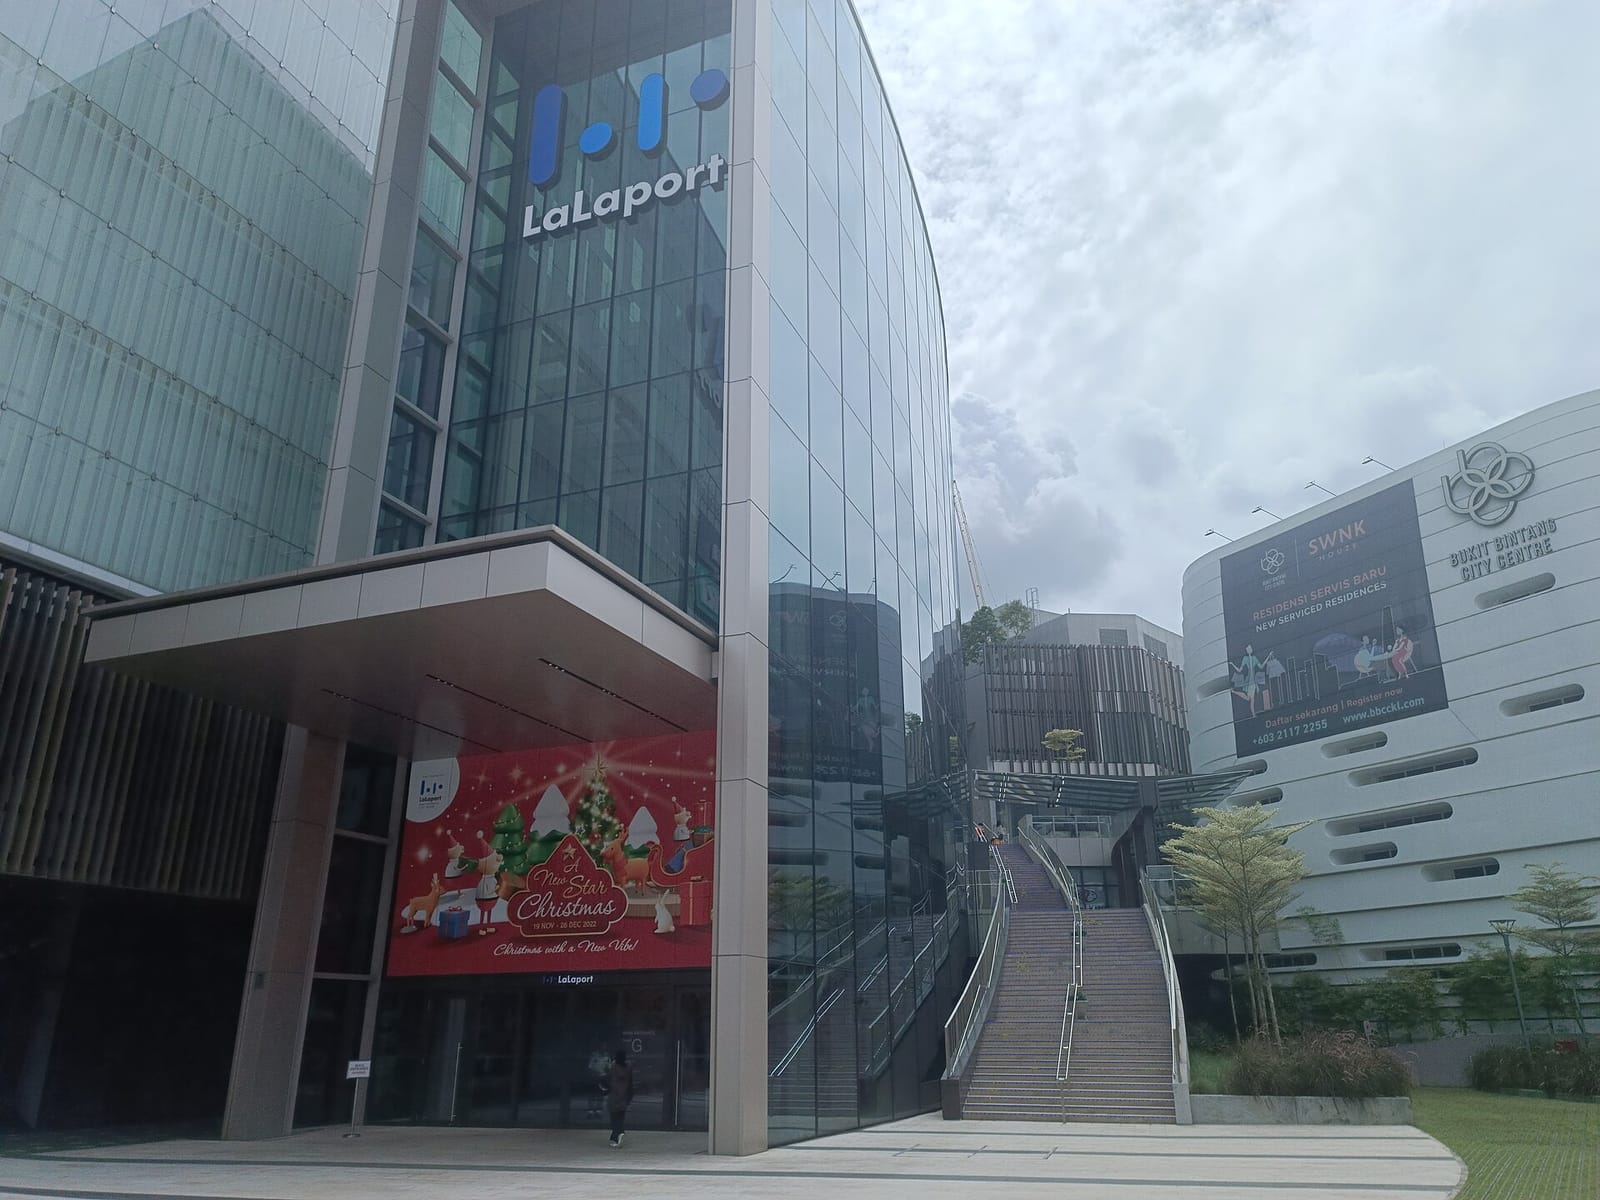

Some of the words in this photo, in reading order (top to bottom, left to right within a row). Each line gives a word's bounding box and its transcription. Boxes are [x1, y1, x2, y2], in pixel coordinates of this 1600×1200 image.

[522, 153, 724, 239] LaLaport
[1308, 519, 1367, 556] SWNK
[1450, 541, 1489, 568] BUKIT
[1495, 518, 1557, 551] BINTANG
[1461, 559, 1492, 581] CITY
[1497, 538, 1553, 569] CENTRE
[1253, 595, 1308, 621] RESIDENSI
[1310, 578, 1351, 601] SERVIS
[1353, 566, 1386, 584] BARU
[1255, 618, 1277, 633] NEW
[1278, 602, 1323, 625] SERVICED
[1325, 582, 1387, 608] RESIDENCES
[1252, 733, 1275, 746] +603
[1277, 725, 1301, 741] 2117
[1303, 718, 1329, 734] 2255
[1342, 696, 1426, 725] www.bbcckl.com
[1265, 715, 1294, 729] Daftar
[1384, 686, 1404, 697] now
[533, 869, 568, 888] New
[562, 875, 608, 899] Star
[563, 859, 581, 874] A
[517, 891, 616, 920] Christmas
[541, 922, 554, 930] NOV
[493, 943, 543, 957] Christmas
[544, 940, 567, 955] with
[568, 945, 576, 953] a
[577, 940, 608, 954] New
[557, 975, 594, 985] LaLaport
